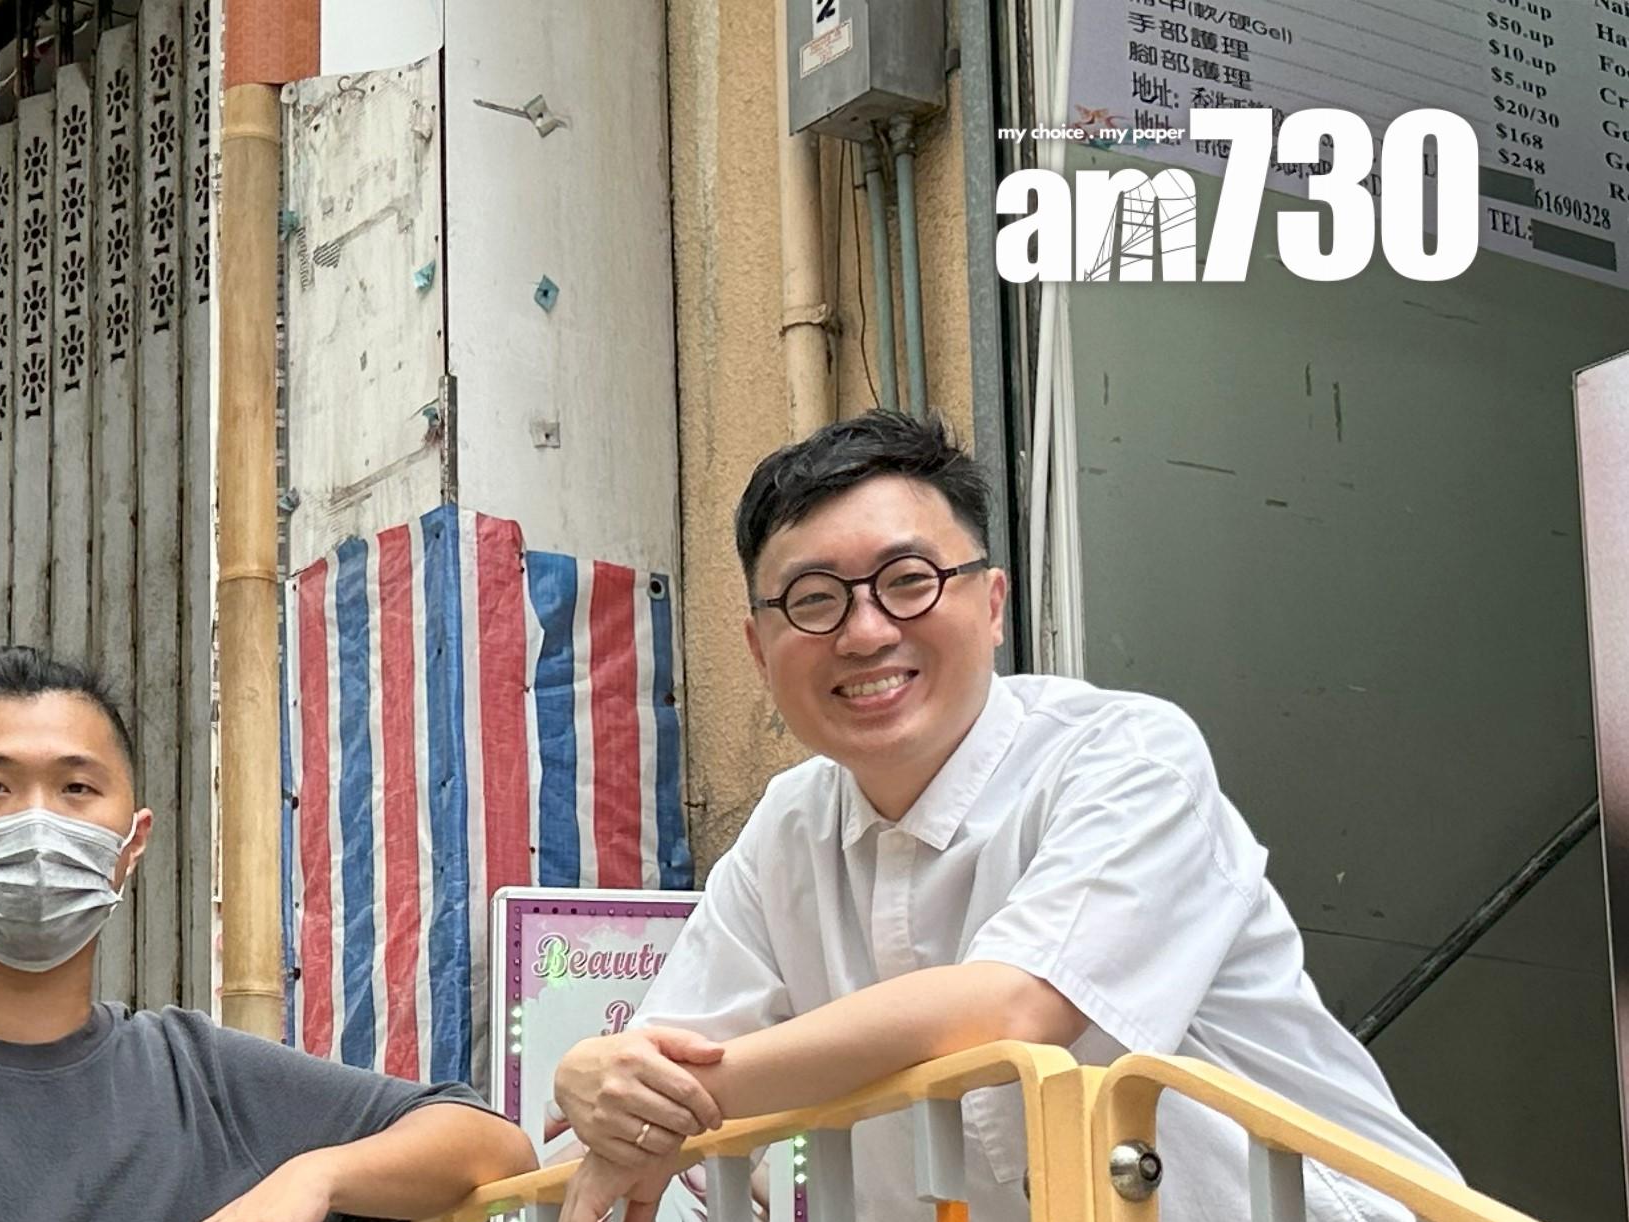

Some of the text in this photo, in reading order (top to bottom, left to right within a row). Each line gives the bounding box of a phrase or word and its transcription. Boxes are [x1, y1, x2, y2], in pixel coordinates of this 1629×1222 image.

[1127, 11, 1250, 62] 手部護理
[1486, 11, 1555, 48] $50.up
[1488, 39, 1557, 76] $10.up
[1490, 66, 1548, 100] $5.up
[1493, 95, 1560, 129] $20/30
[1495, 123, 1544, 150] $168
[1497, 148, 1546, 175] $248
[1535, 188, 1612, 230] 61690328
